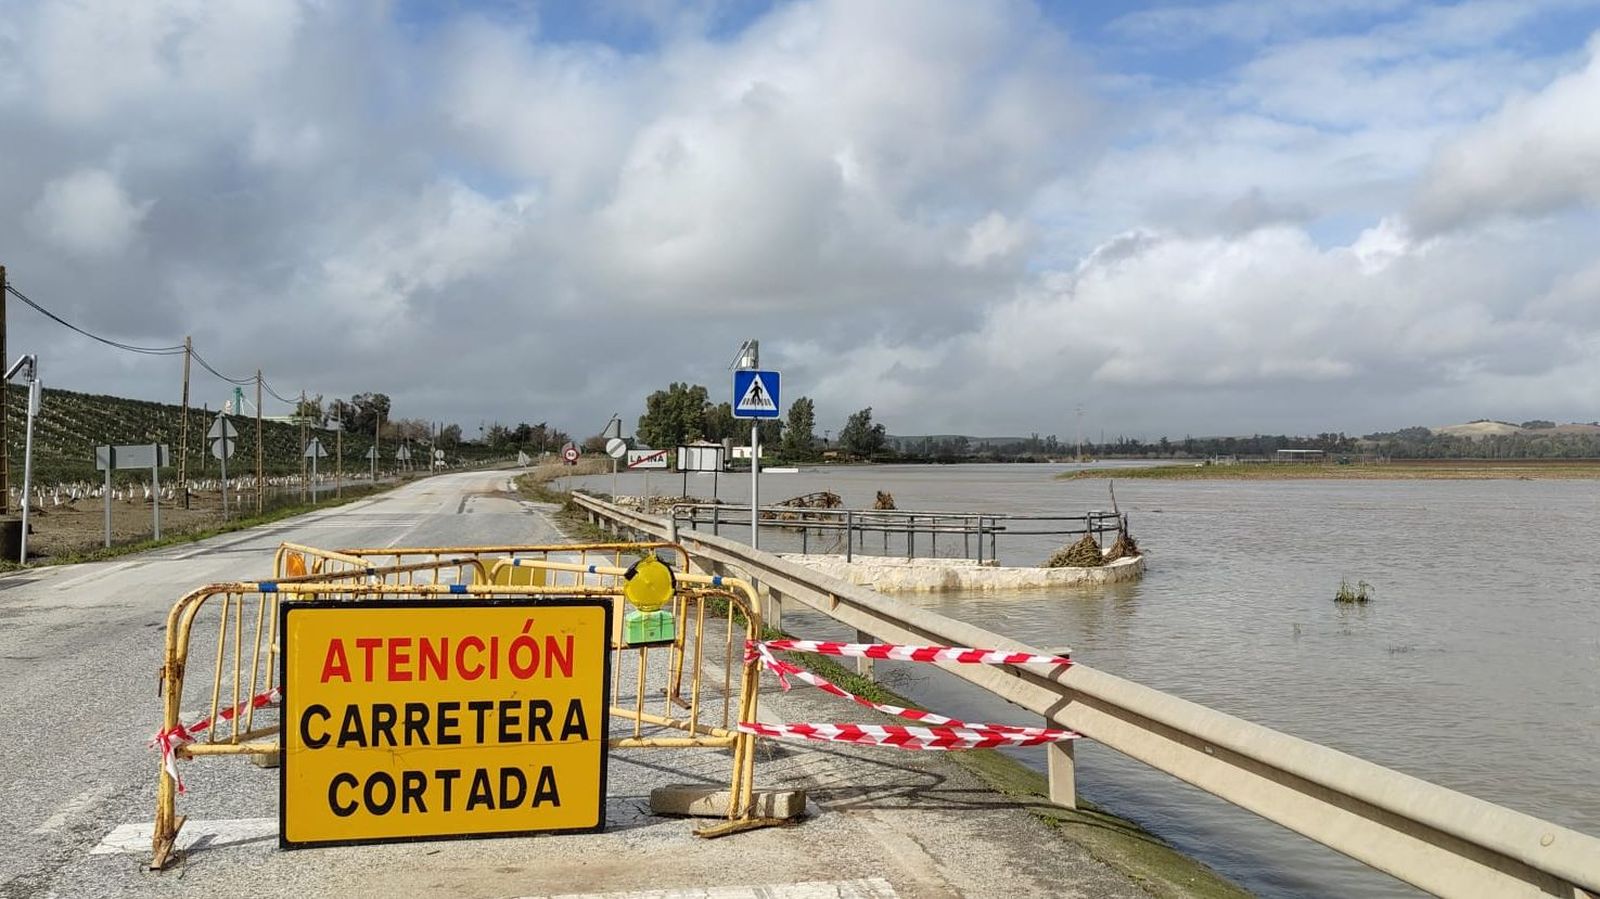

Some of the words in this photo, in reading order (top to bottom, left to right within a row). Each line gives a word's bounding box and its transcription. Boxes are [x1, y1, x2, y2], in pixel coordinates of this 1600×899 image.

[630, 455, 642, 463] LA
[320, 618, 574, 683] ATENCIÓN
[300, 698, 589, 749] CARRETERA
[328, 766, 560, 817] CORTADA
